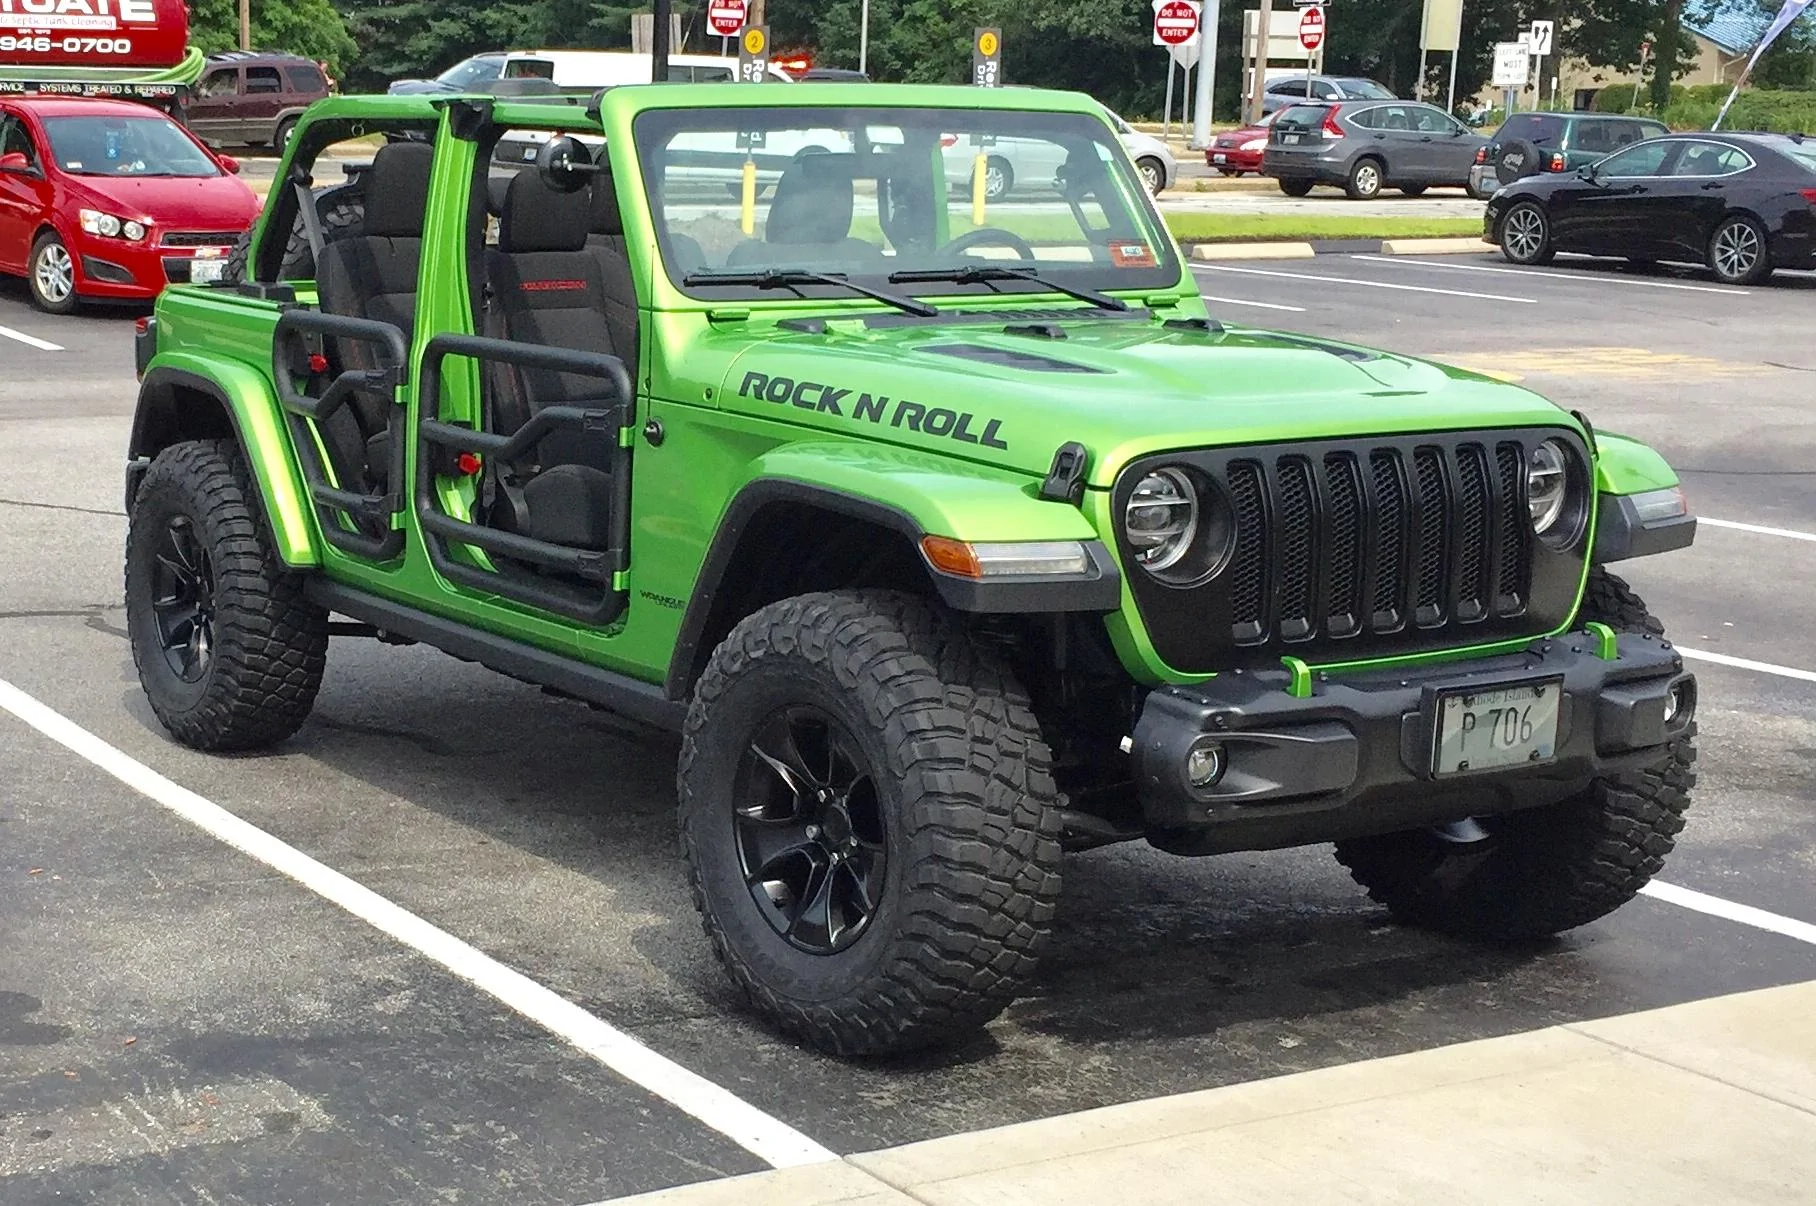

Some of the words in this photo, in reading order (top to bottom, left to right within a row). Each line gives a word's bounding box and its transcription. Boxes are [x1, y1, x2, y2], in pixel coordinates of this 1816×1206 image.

[1161, 9, 1173, 17] DO
[1176, 9, 1193, 18] NOT
[715, 19, 738, 28] ENTER
[1162, 28, 1189, 37] ENTER
[0, 36, 131, 54] 946-0700
[751, 35, 759, 49] 2
[985, 38, 992, 50] 3
[39, 83, 82, 93] SYSTEMS
[83, 84, 122, 95] TREATED
[124, 85, 132, 94] &
[739, 371, 853, 417] ROCK
[852, 393, 890, 423] N
[890, 400, 1008, 450] ROLL
[1461, 711, 1476, 752] P
[1488, 704, 1533, 748] 706
